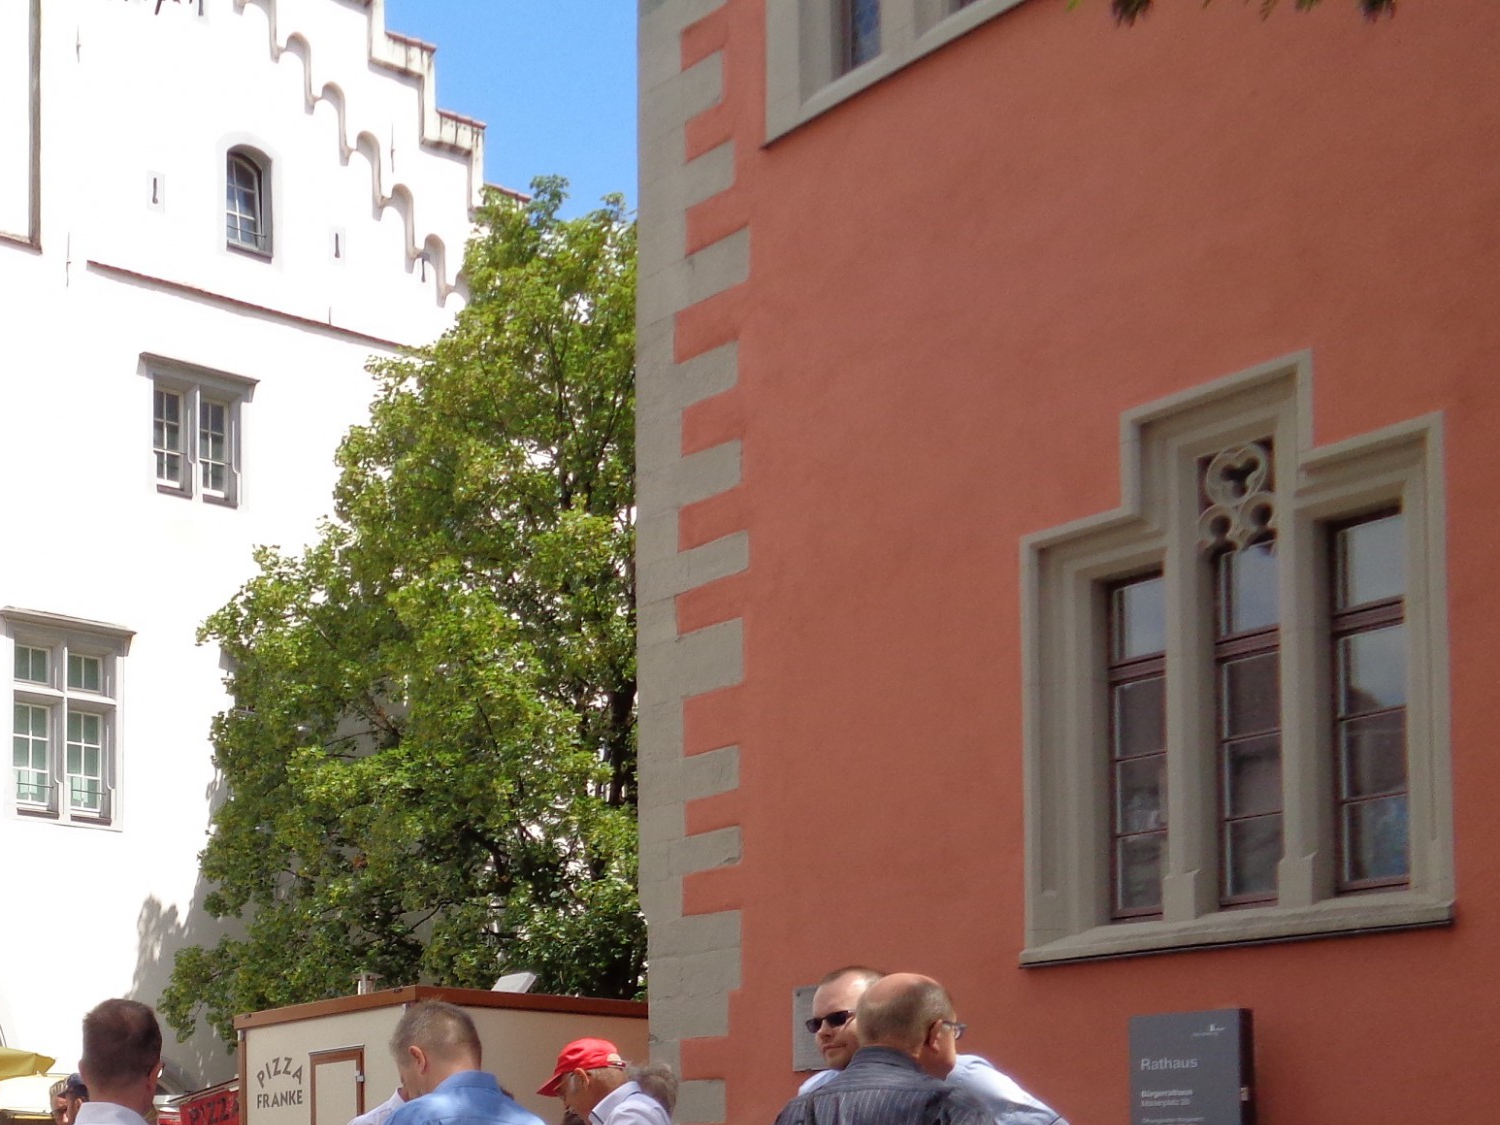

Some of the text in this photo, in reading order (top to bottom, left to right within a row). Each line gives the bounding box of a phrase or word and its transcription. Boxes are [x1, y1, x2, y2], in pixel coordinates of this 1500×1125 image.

[256, 1056, 303, 1089] PIZZA
[1140, 1057, 1199, 1071] Rathaus
[256, 1089, 303, 1109] FRANKE
